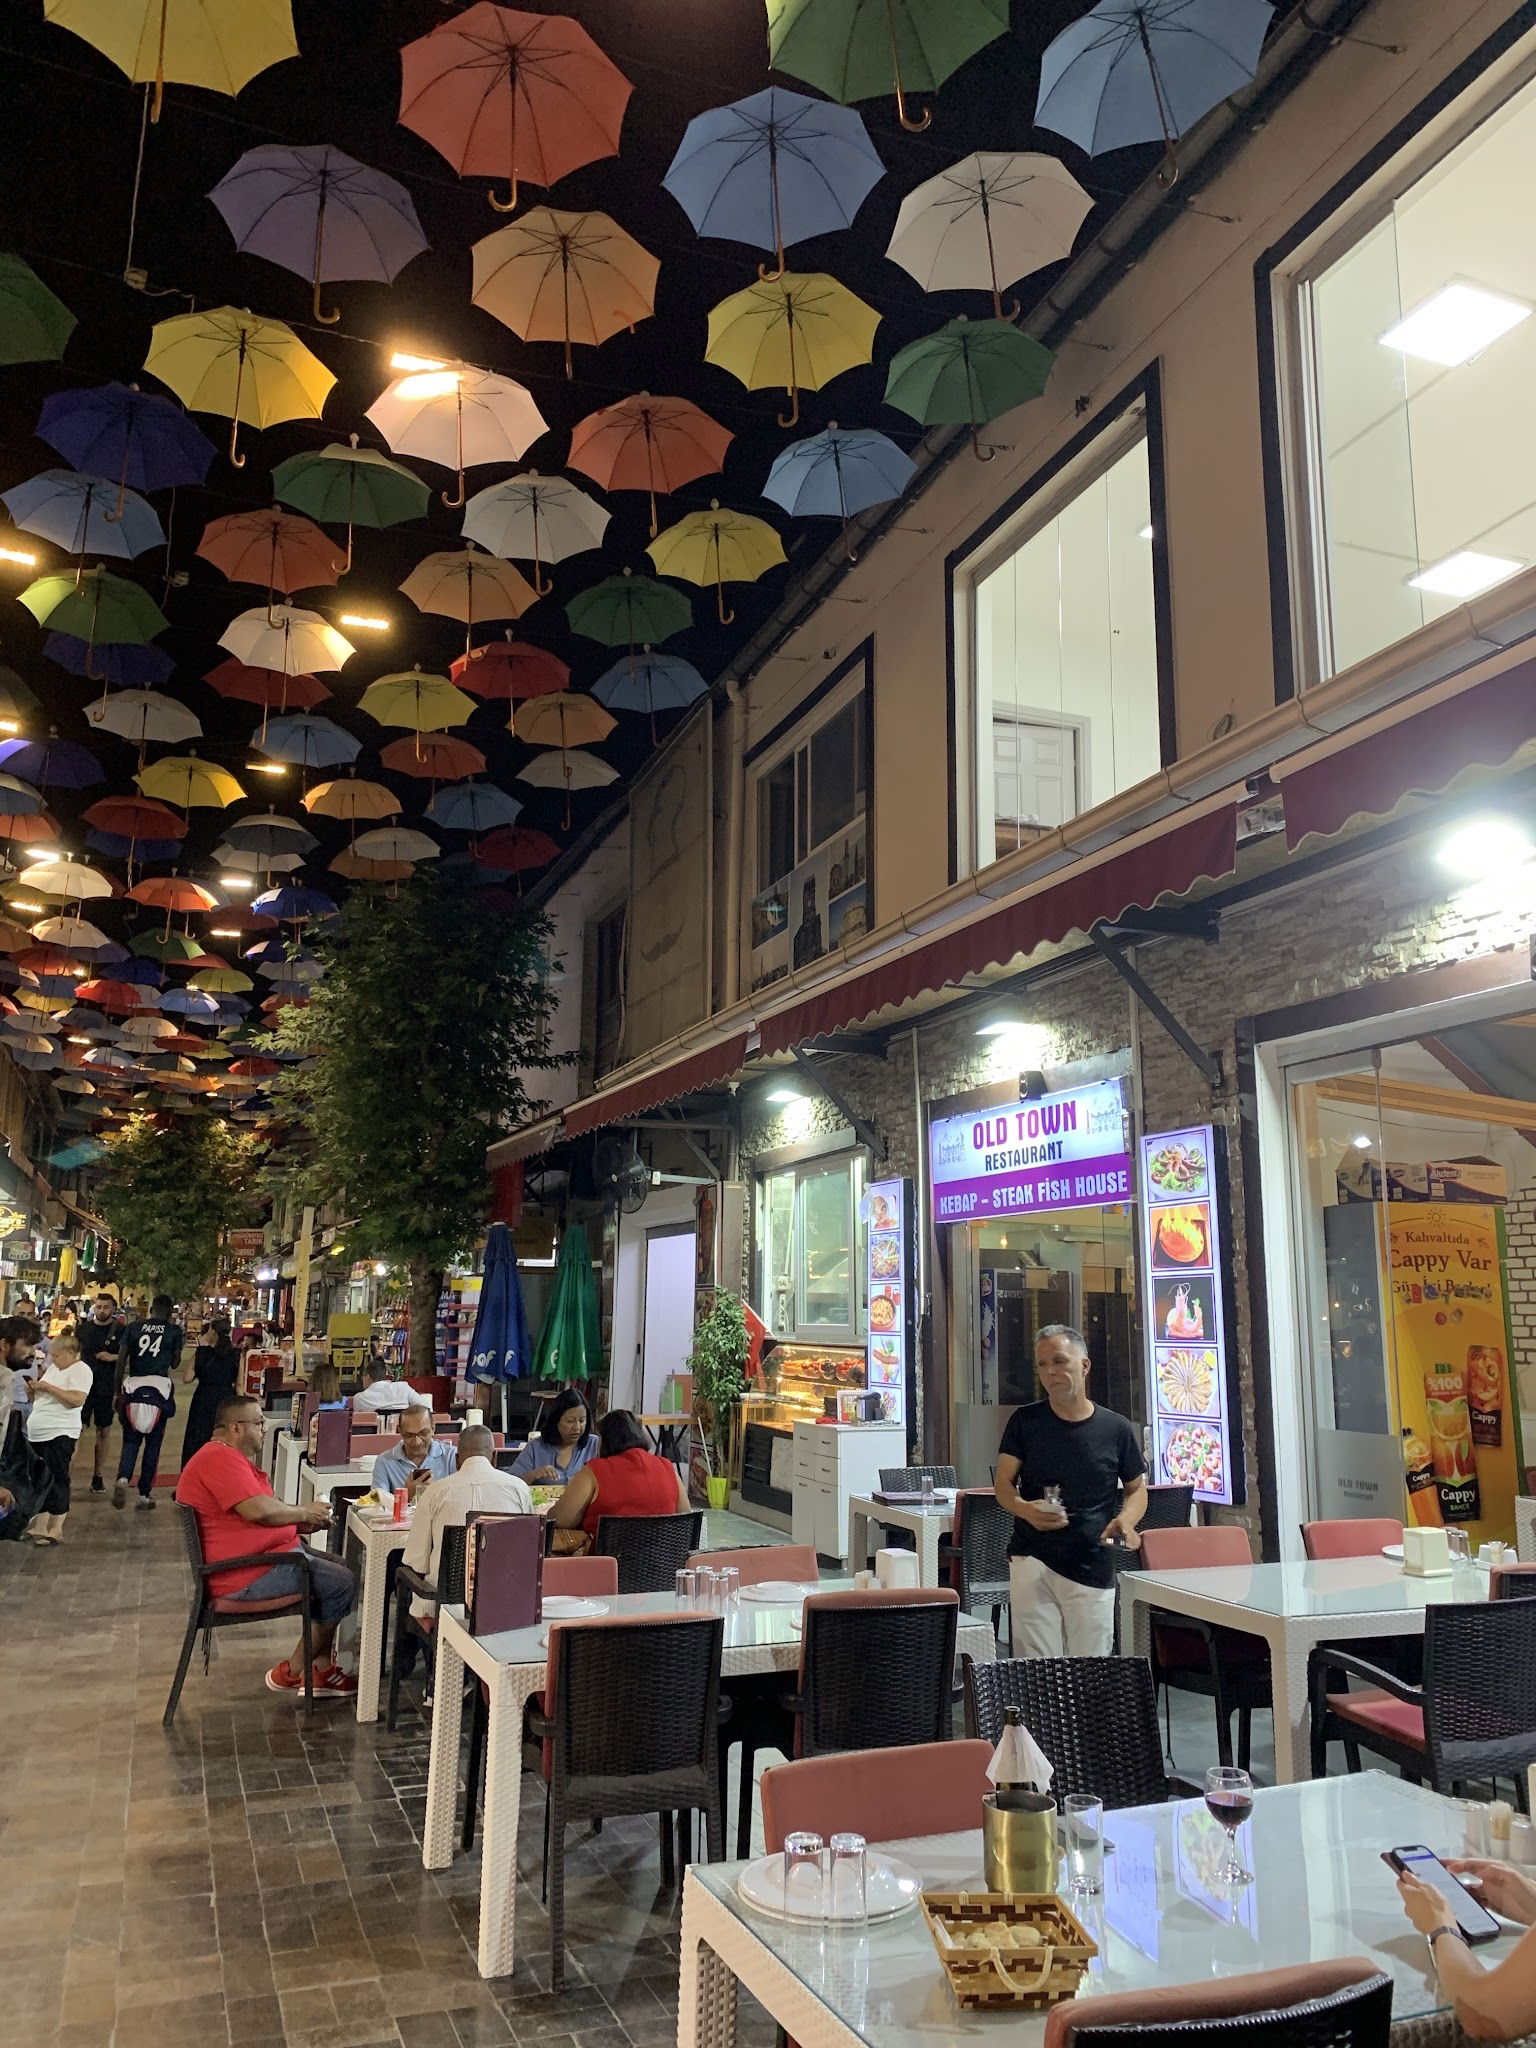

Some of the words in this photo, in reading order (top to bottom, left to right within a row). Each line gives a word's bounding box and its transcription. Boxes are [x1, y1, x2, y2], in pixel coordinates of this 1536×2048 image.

[973, 1117, 1008, 1150] OLD
[1015, 1100, 1077, 1140] TOWN
[985, 1140, 1064, 1171] RESTAURANT
[940, 1192, 977, 1215] KEBAP
[992, 1183, 1034, 1208] STEAK
[1076, 1170, 1128, 1197] HOUSE
[1391, 1249, 1450, 1273] Cappy
[1456, 1249, 1492, 1271] Var
[138, 1334, 163, 1358] 94
[1426, 1376, 1463, 1391] %100
[1472, 1410, 1498, 1425] Cappy
[1412, 1472, 1431, 1482] Cappy
[1440, 1488, 1476, 1504] Cappy
